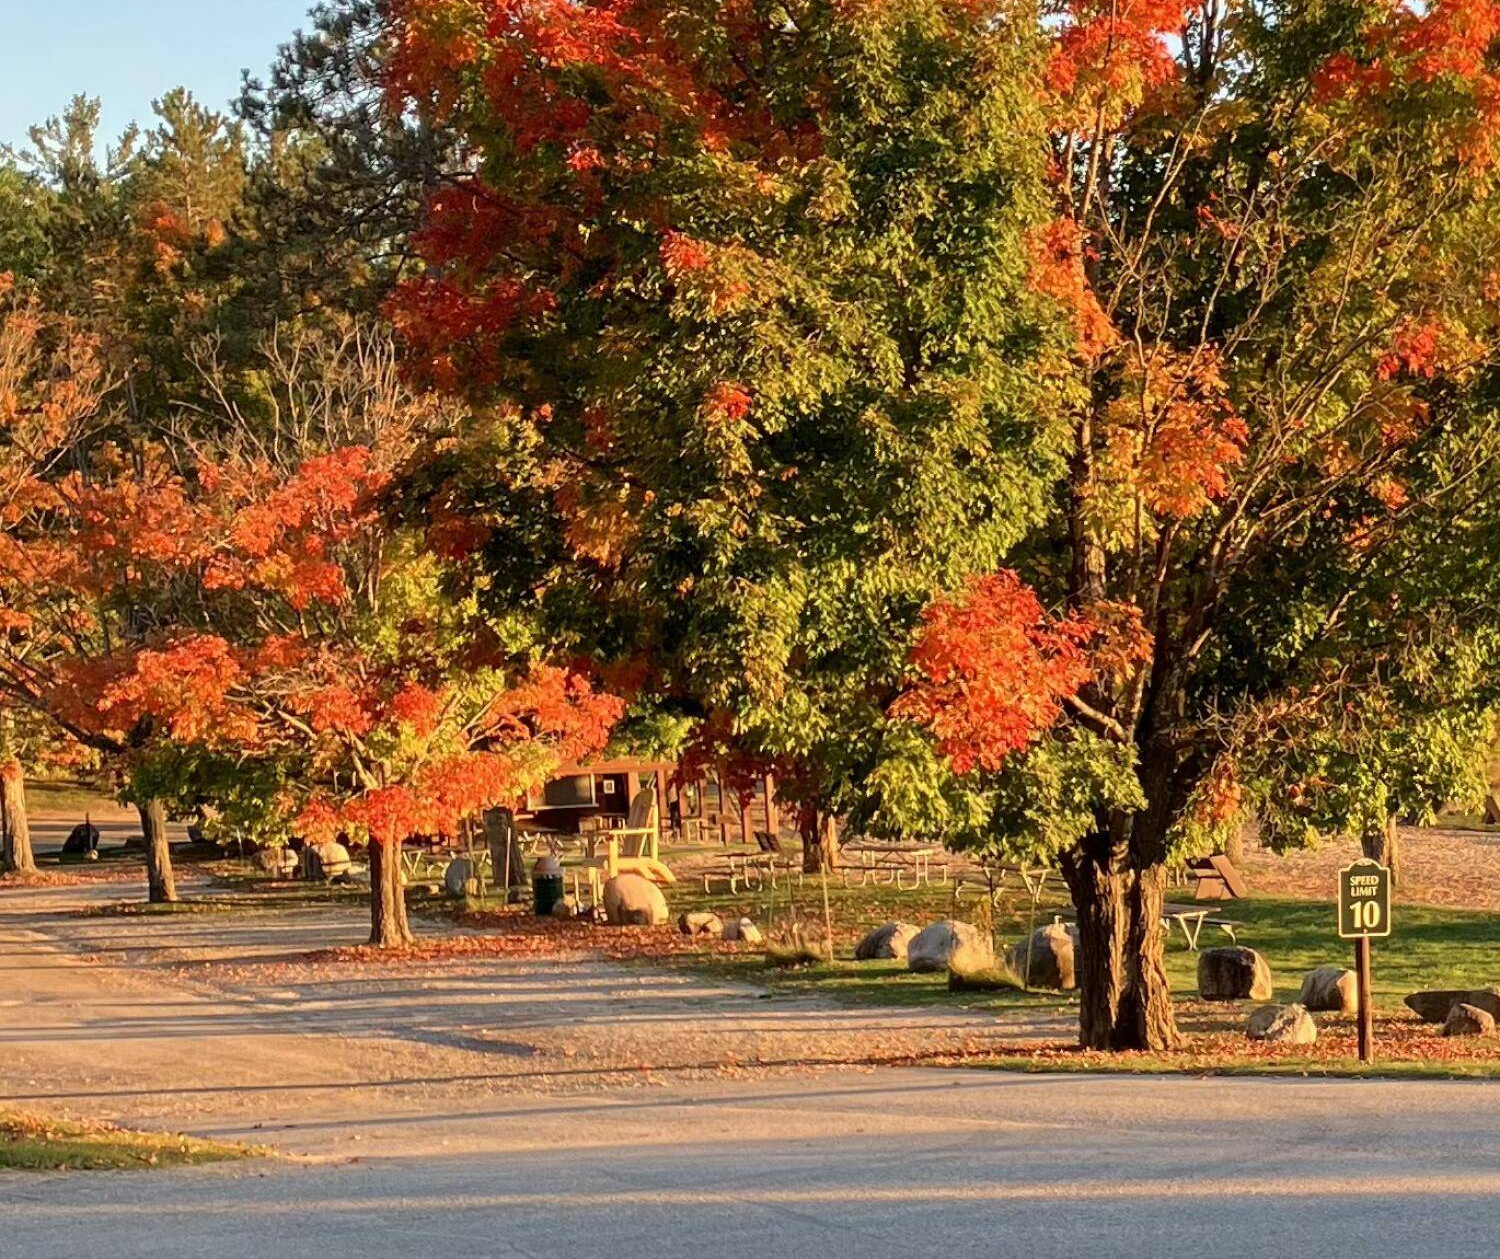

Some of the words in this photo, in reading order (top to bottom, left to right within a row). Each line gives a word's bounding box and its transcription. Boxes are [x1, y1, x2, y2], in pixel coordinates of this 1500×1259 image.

[1349, 875, 1379, 886] SPEED
[1350, 886, 1378, 897] LIMIT
[1349, 900, 1380, 928] 10
